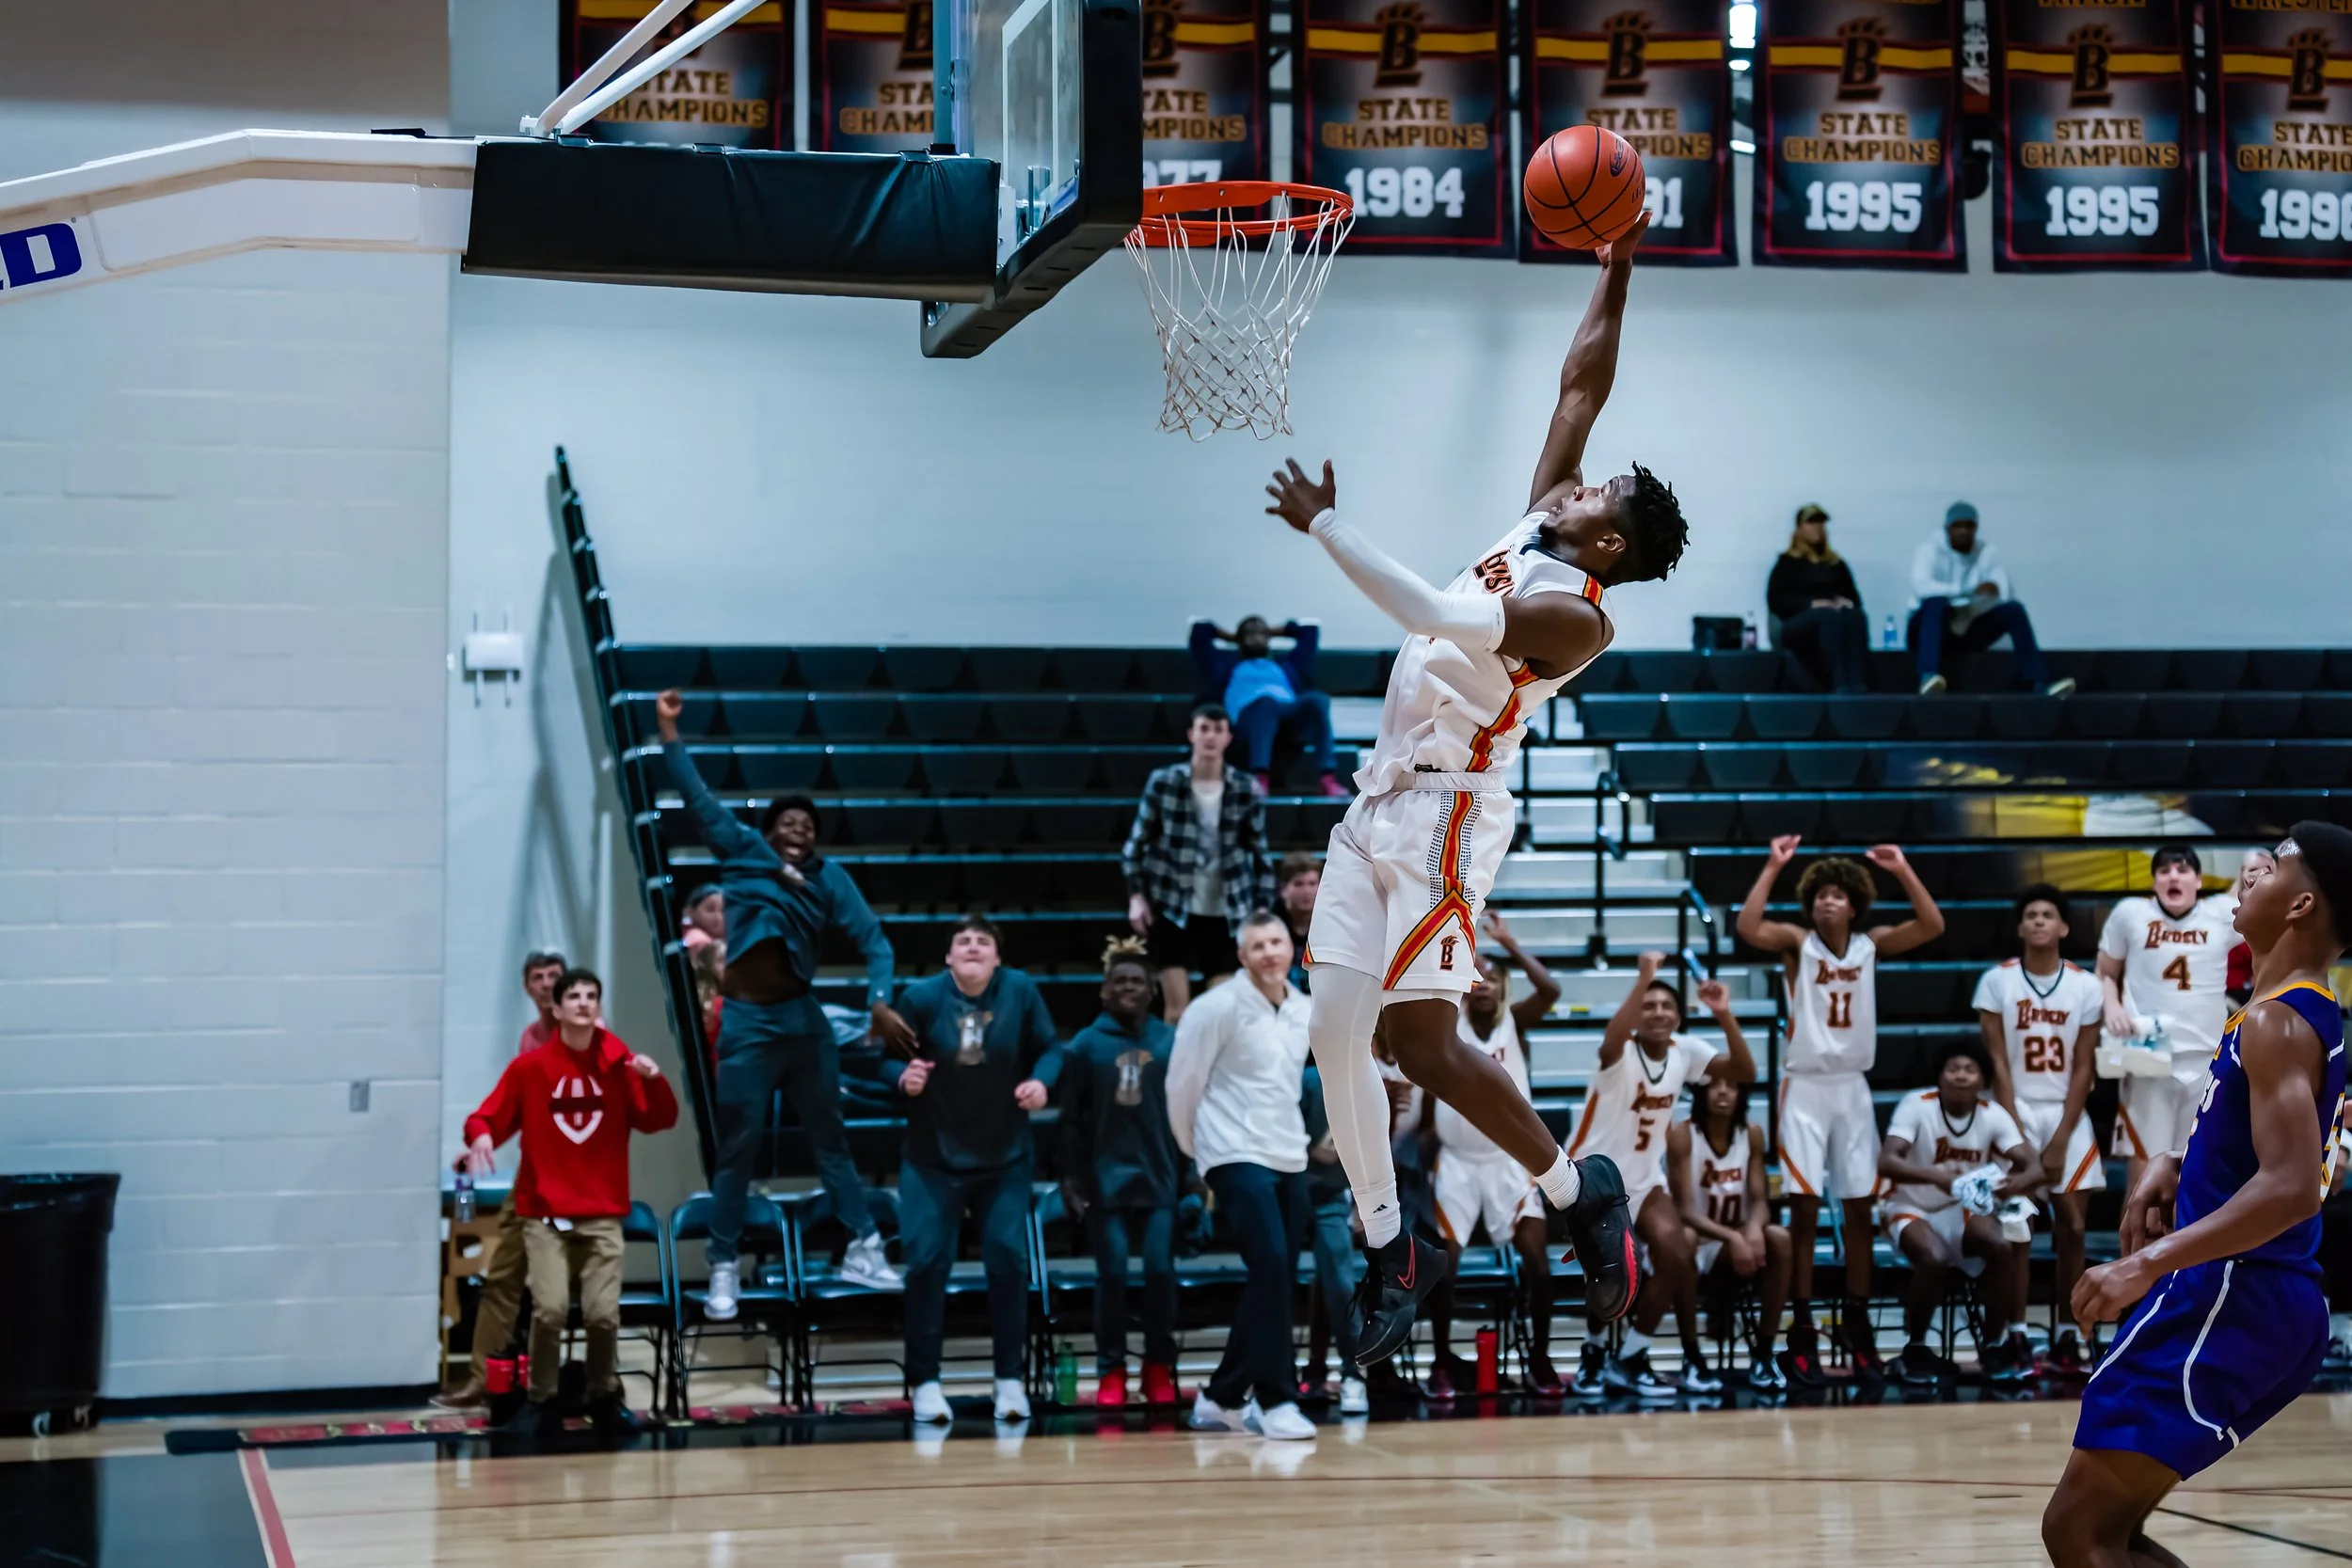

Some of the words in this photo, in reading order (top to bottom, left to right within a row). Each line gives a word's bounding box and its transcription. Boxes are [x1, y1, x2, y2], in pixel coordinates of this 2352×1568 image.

[607, 97, 769, 126] HAMPIONS
[1359, 98, 1450, 120] STATE
[1820, 113, 1907, 136] STATE
[1324, 124, 1486, 148] CHAMPIONS
[2056, 119, 2142, 140] STATE
[1788, 140, 1940, 164] CHAMPIONS
[2025, 146, 2179, 167] CHAMPIONS
[1344, 167, 1465, 217] 1984
[1804, 181, 1922, 233] 1995
[2045, 185, 2159, 236] 1995
[2163, 955, 2191, 990] 4
[1827, 990, 1852, 1028] 11
[2024, 1036, 2065, 1072] 23
[1634, 1116, 1656, 1151] 5
